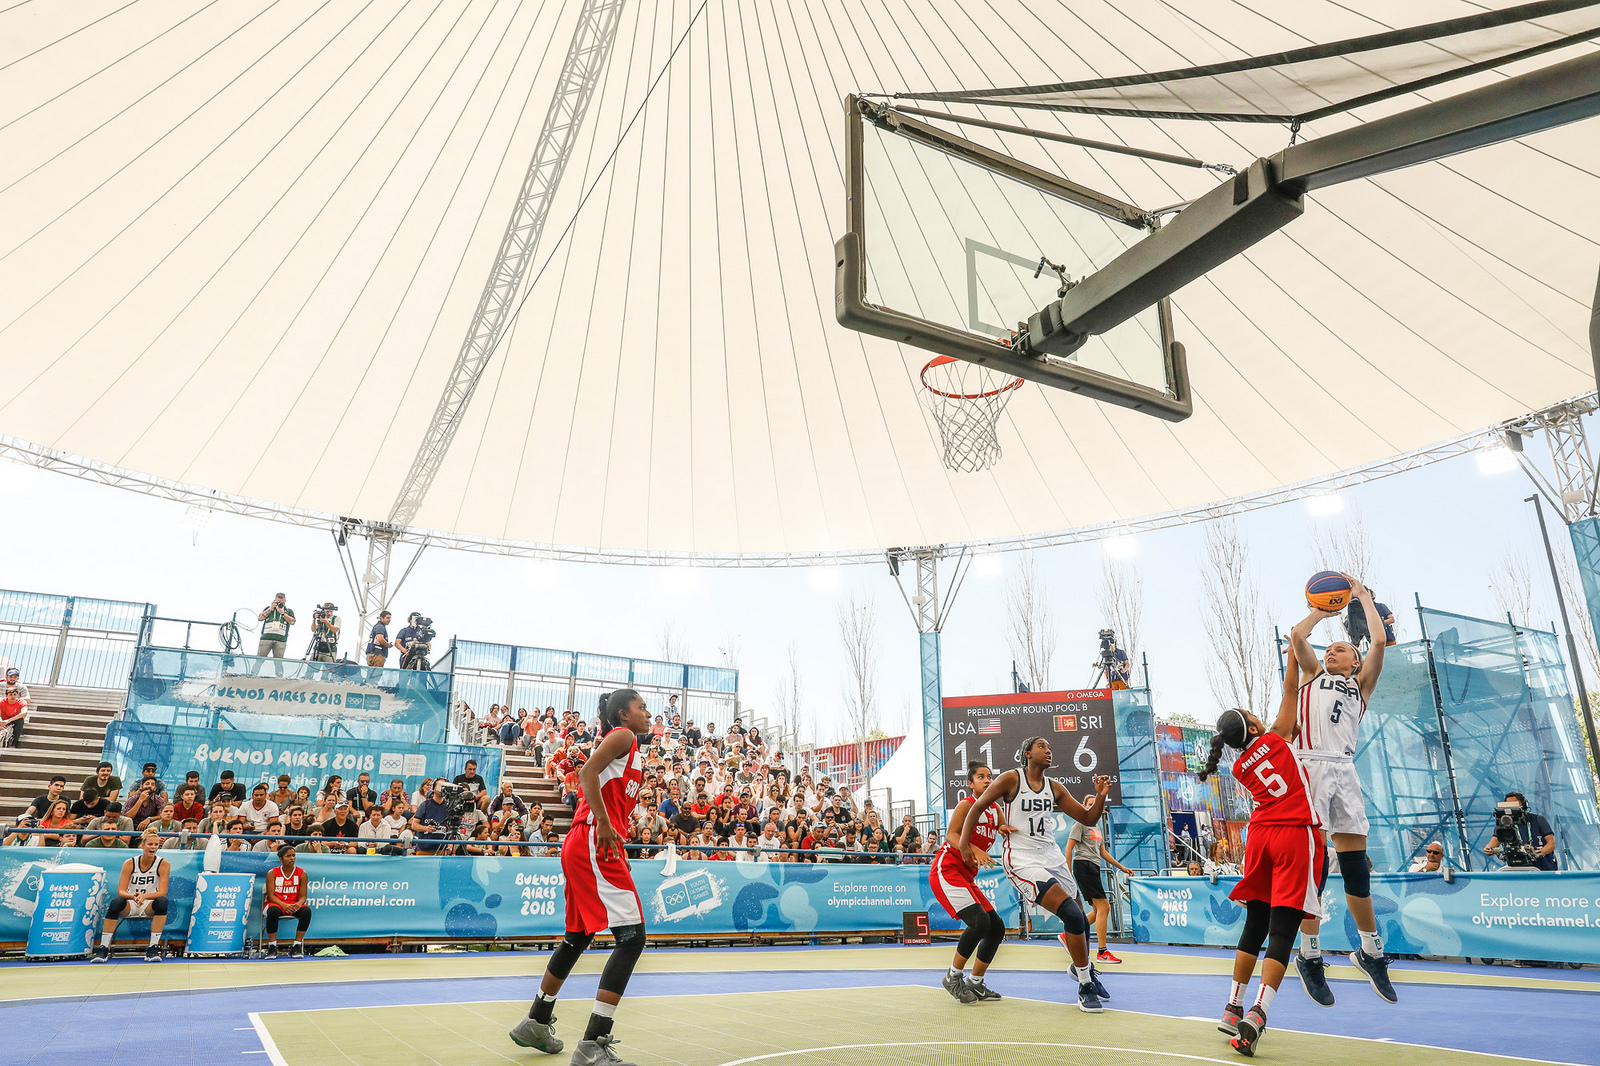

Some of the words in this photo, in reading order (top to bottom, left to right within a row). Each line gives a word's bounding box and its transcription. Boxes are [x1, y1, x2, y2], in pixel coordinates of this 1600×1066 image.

[268, 689, 306, 703] AIRES
[309, 692, 341, 705] 2018
[1320, 679, 1359, 701] USA
[967, 706, 1020, 717] PRELIMINARY
[1023, 705, 1053, 714] ROUND
[1056, 704, 1080, 712] POOL
[1082, 703, 1088, 711] B
[1330, 700, 1343, 723] 5
[948, 722, 976, 735] USA
[1080, 715, 1102, 729] SRI
[194, 743, 273, 766] BUENOS
[277, 750, 328, 769] AIRES
[332, 753, 375, 770] 2018
[954, 739, 1000, 776] 11
[1073, 736, 1097, 772] 6
[295, 773, 317, 785] the
[1254, 759, 1288, 797] 5
[625, 779, 640, 798] SRI
[1021, 799, 1052, 811] USA
[1028, 817, 1045, 836] 14
[131, 876, 154, 884] USA
[352, 881, 388, 890] more
[392, 881, 409, 890] on
[515, 872, 565, 886] BUENOS
[48, 884, 79, 892] BUENOS
[51, 891, 73, 899] AIRES
[521, 886, 557, 899] AIRES
[833, 882, 867, 895] Explore
[870, 885, 892, 893] more
[1157, 888, 1192, 899] BUENOS
[50, 899, 72, 907] 2018
[305, 894, 415, 909] mpicchannel.com
[520, 900, 555, 916] 2018
[827, 896, 912, 908] olympicchannel.com
[1161, 900, 1188, 912] AIRES
[1480, 892, 1540, 911] Explore
[1545, 897, 1589, 907] more
[916, 916, 928, 935] 5
[1163, 912, 1188, 927] 2018
[1472, 911, 1600, 928] olympicchannel.c
